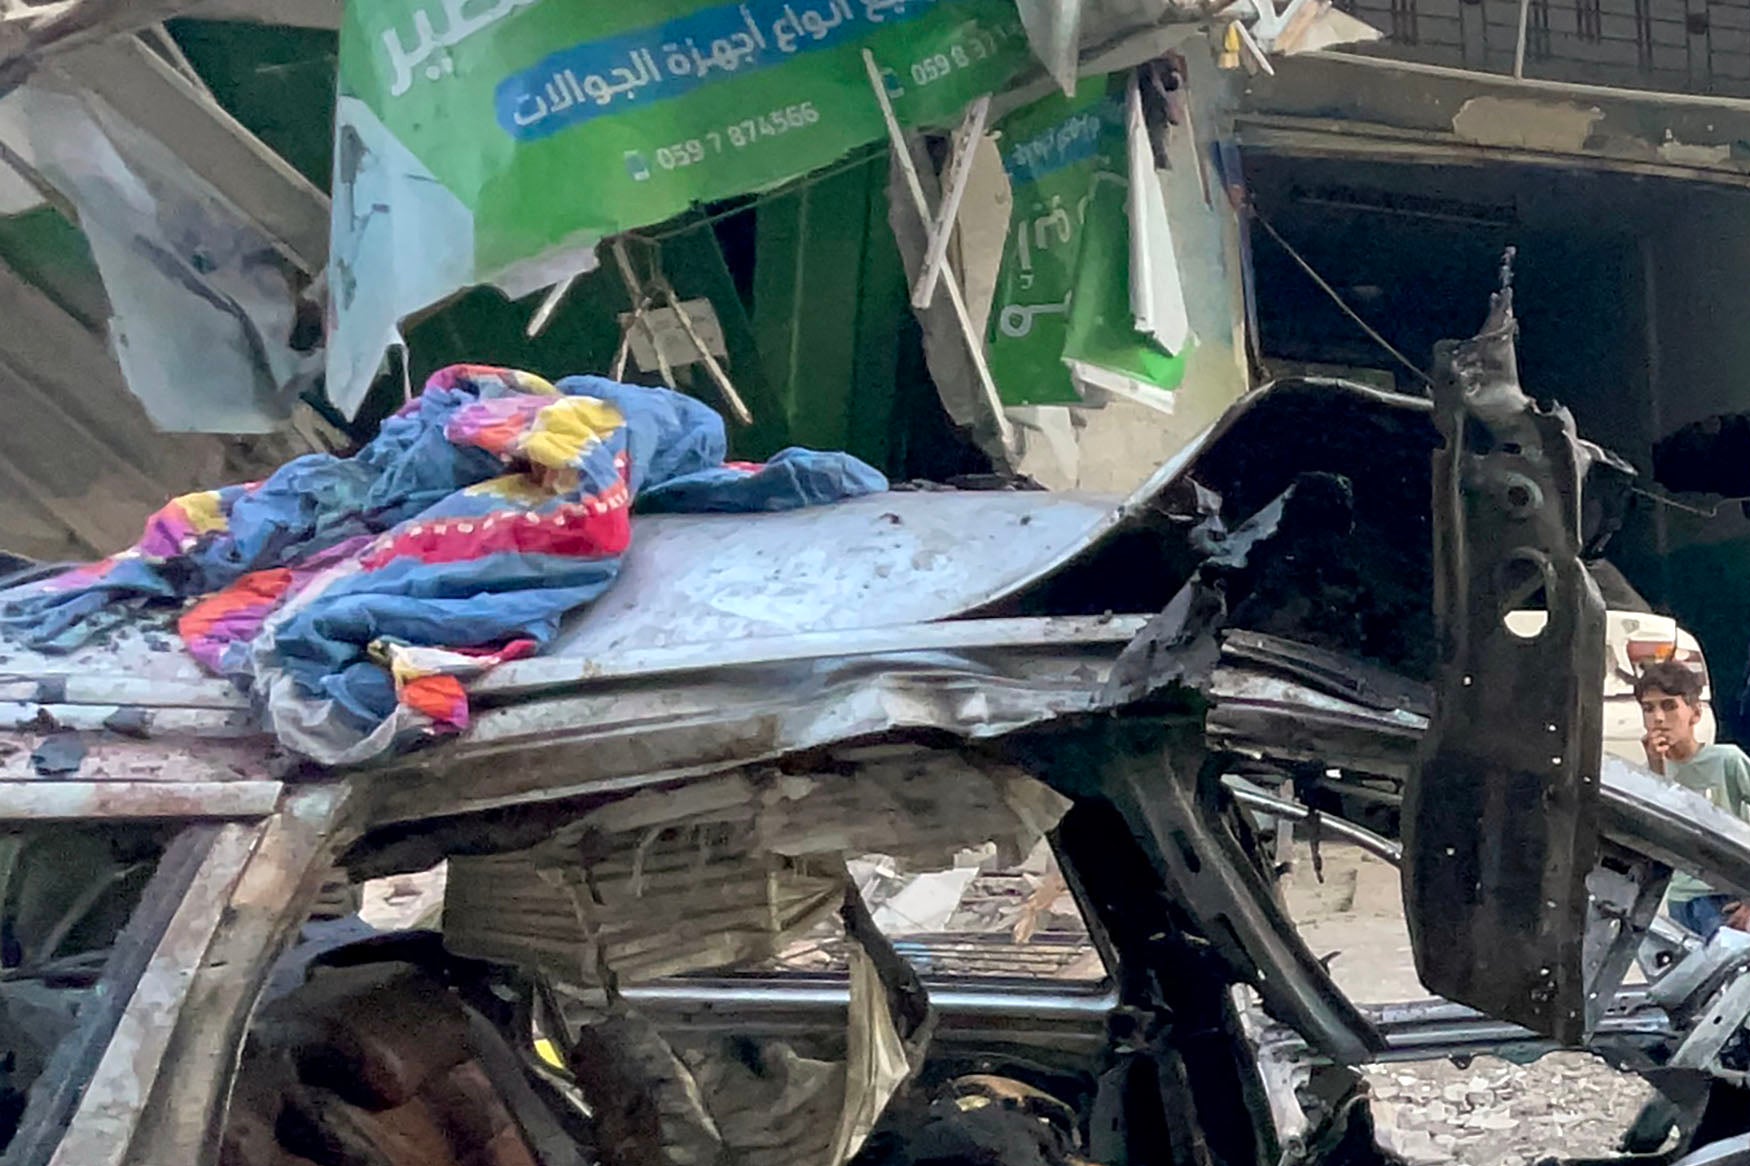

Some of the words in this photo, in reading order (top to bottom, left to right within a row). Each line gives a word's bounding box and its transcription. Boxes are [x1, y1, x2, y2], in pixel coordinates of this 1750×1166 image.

[513, 48, 662, 126] الجوالات
[910, 54, 951, 85] 059
[656, 139, 705, 170] 059
[706, 132, 722, 154] 7
